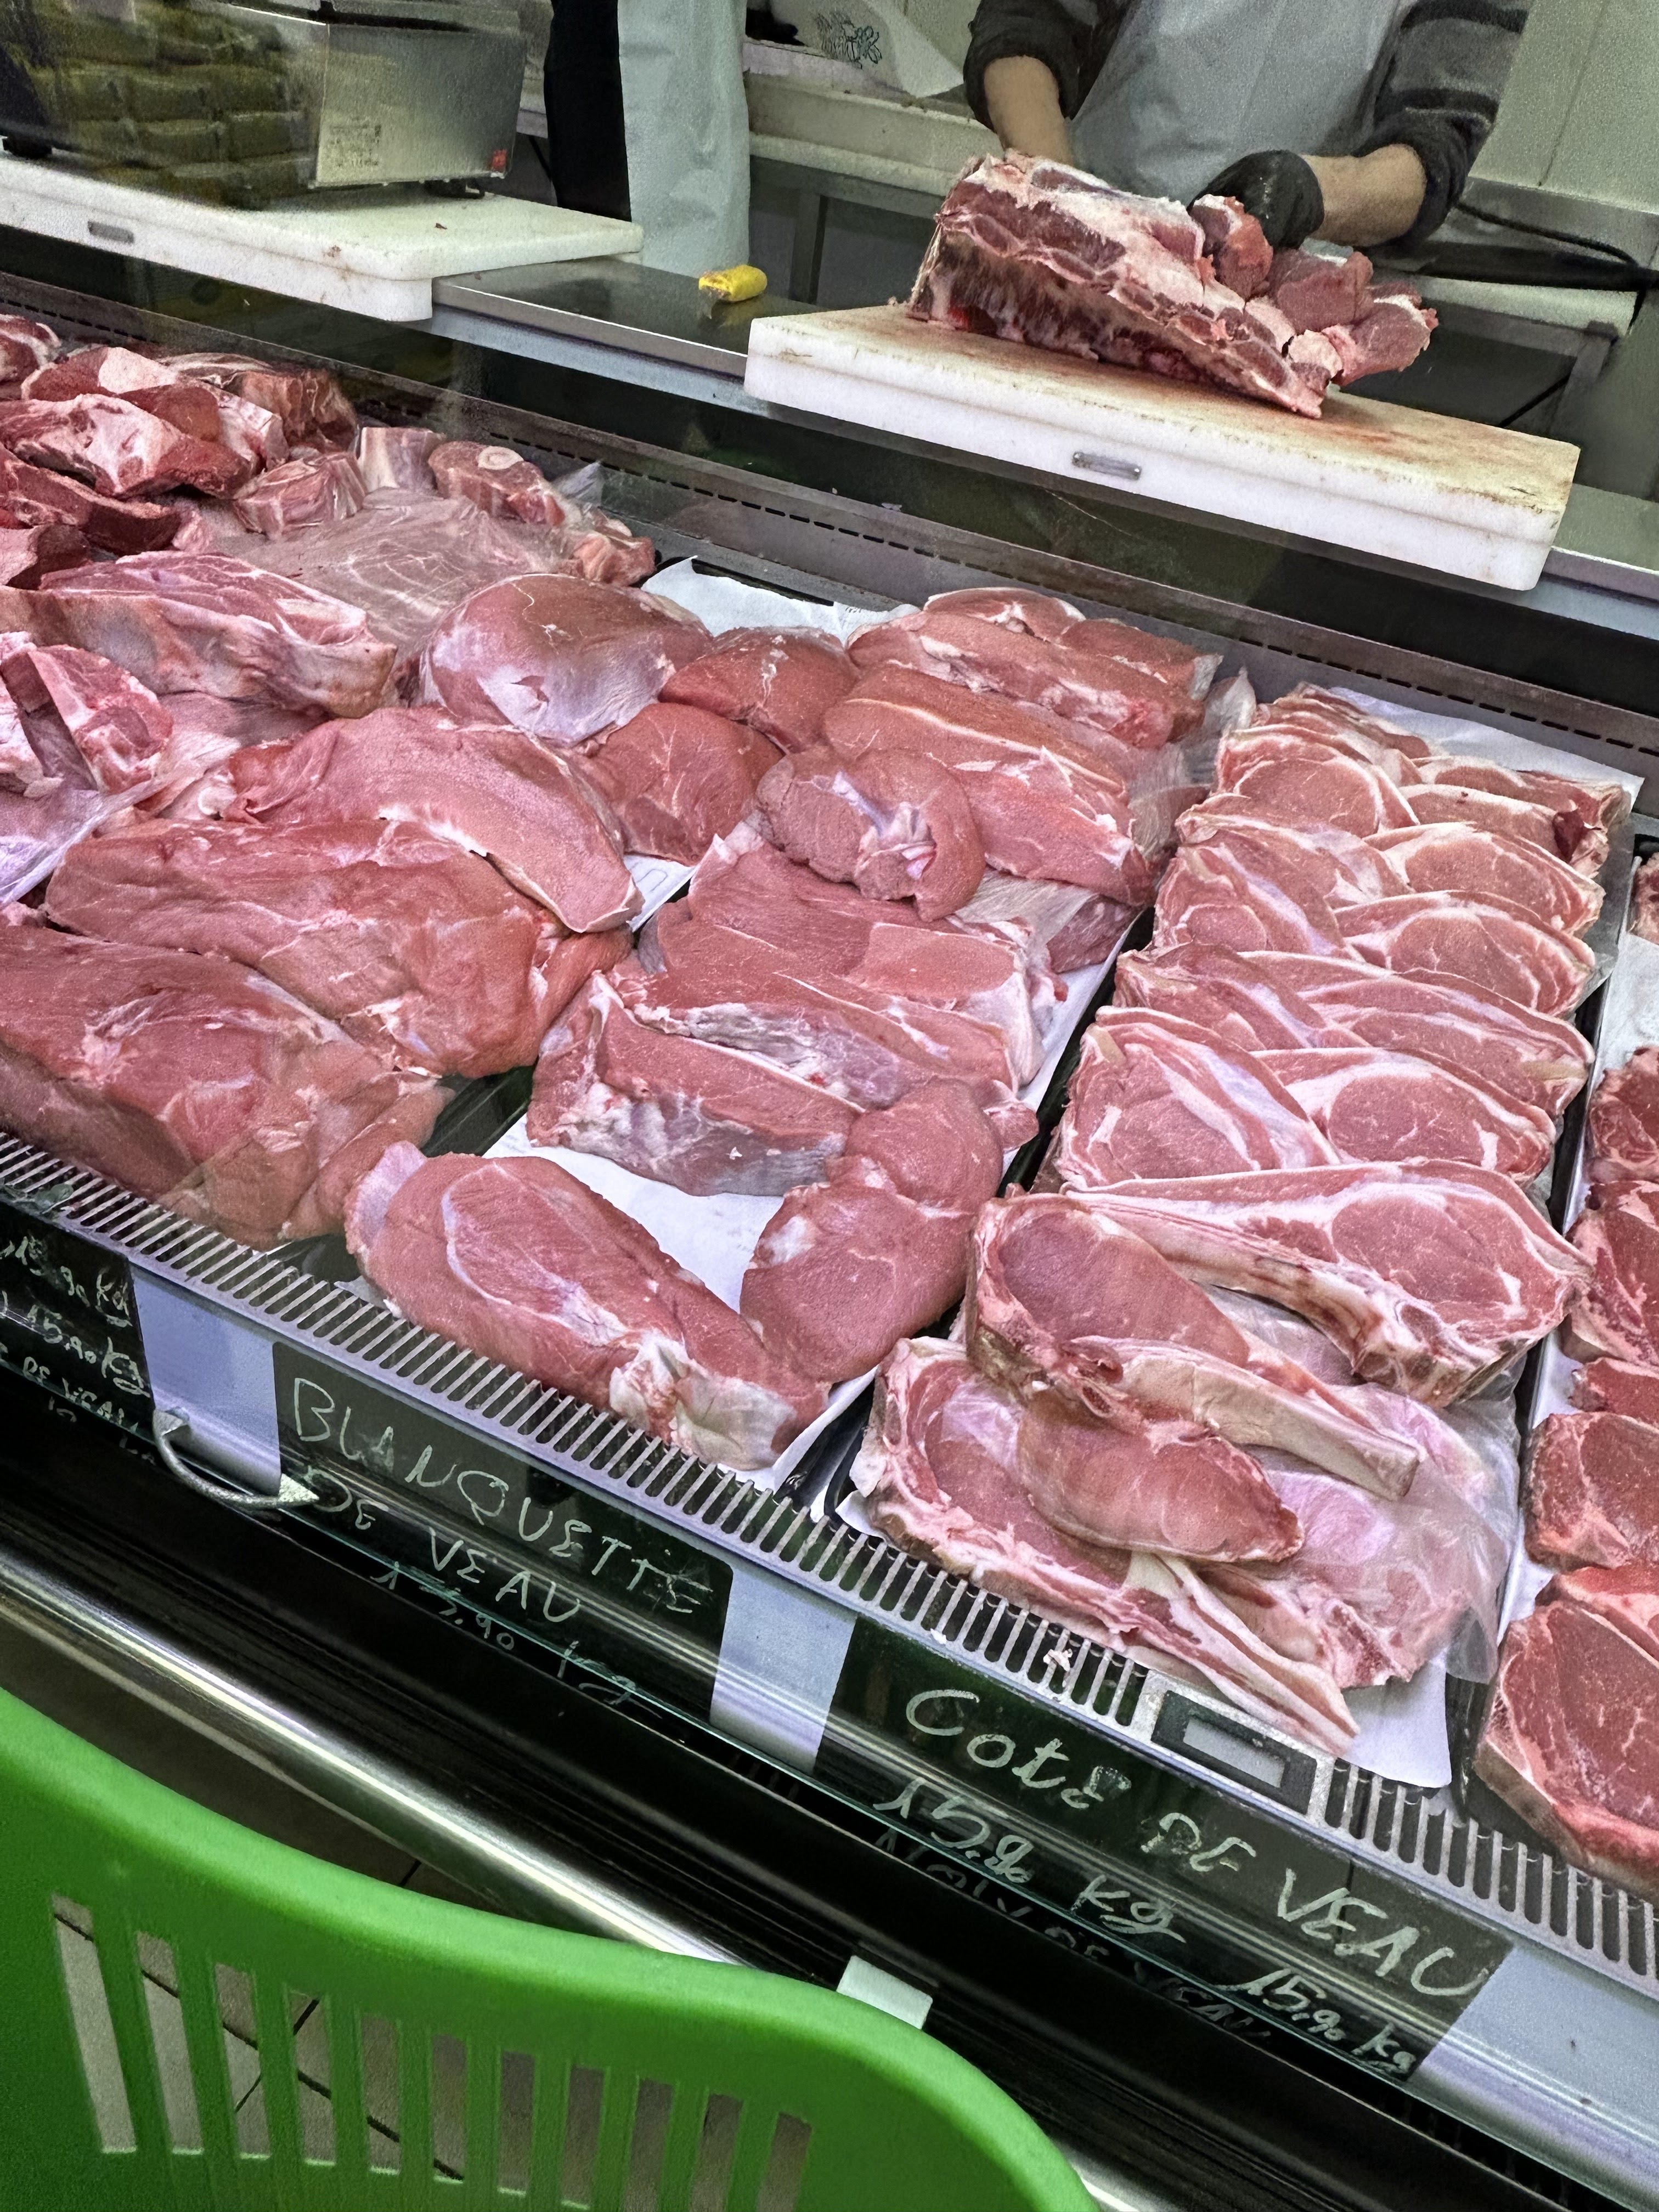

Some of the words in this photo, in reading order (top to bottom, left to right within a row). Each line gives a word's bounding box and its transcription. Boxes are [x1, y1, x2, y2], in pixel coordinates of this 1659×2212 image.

[292, 1377, 714, 1614] BLANQUETTE
[428, 1526, 581, 1622] VEAU
[1277, 1867, 1491, 1997] VEAU
